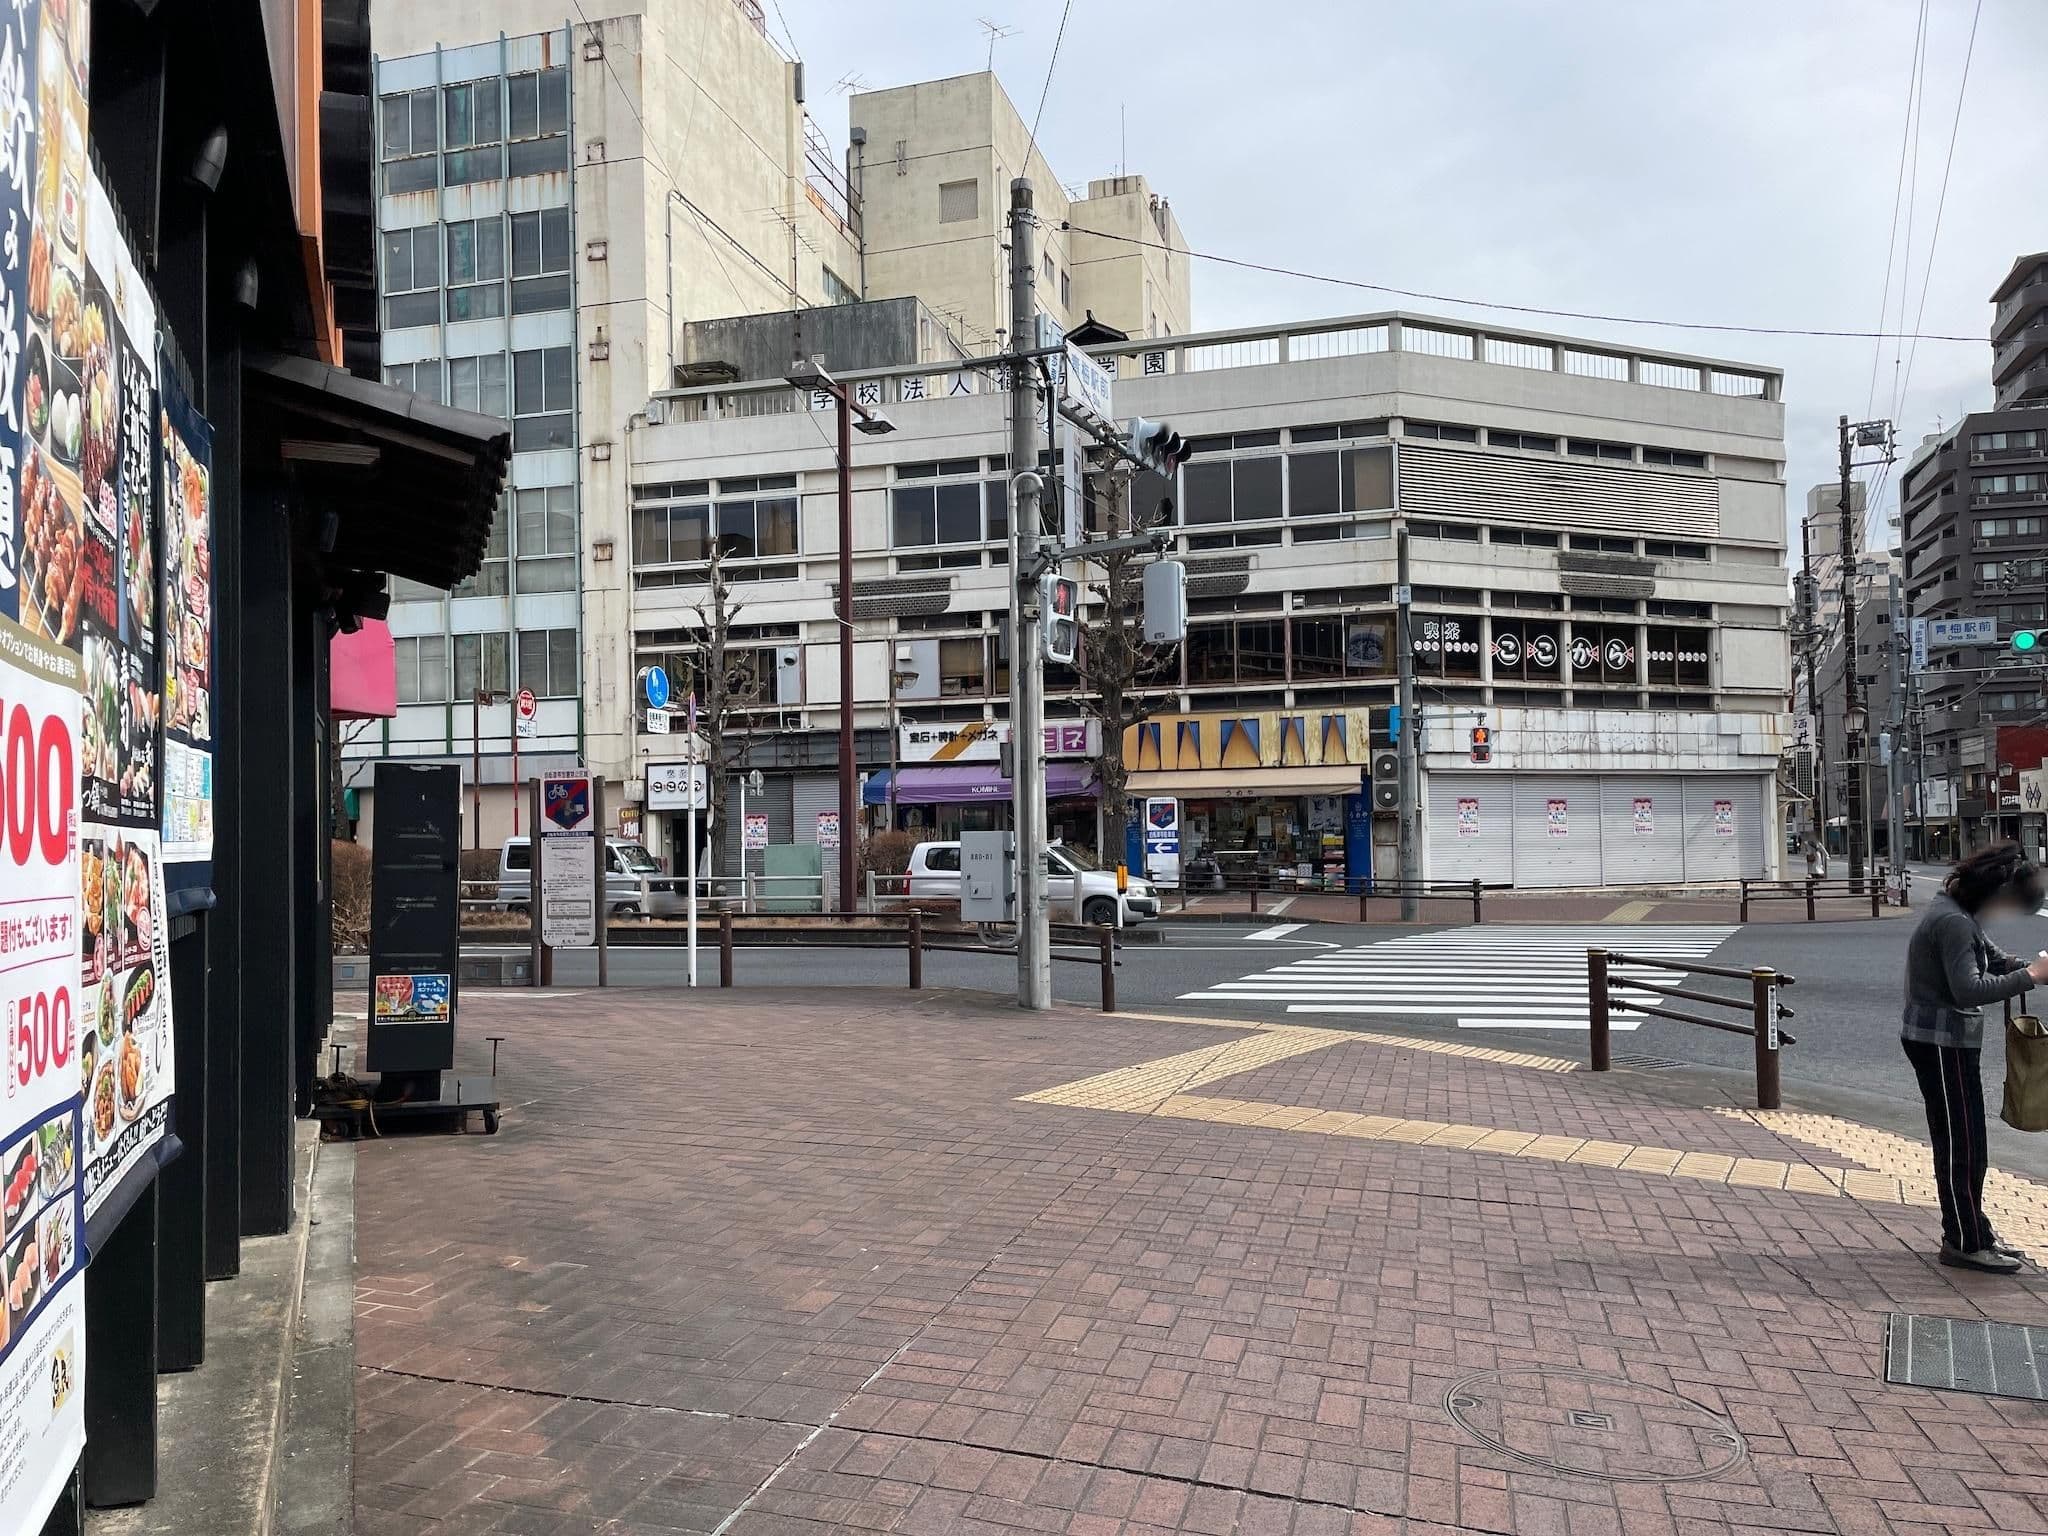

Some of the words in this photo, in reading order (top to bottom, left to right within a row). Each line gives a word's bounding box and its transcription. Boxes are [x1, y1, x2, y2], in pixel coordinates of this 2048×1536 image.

[1423, 621, 1461, 640] 喫茶
[1935, 621, 1991, 635] 青梅駅前
[1499, 638, 1628, 667] ここから
[0, 697, 73, 866] 00
[18, 985, 71, 1087] 500
